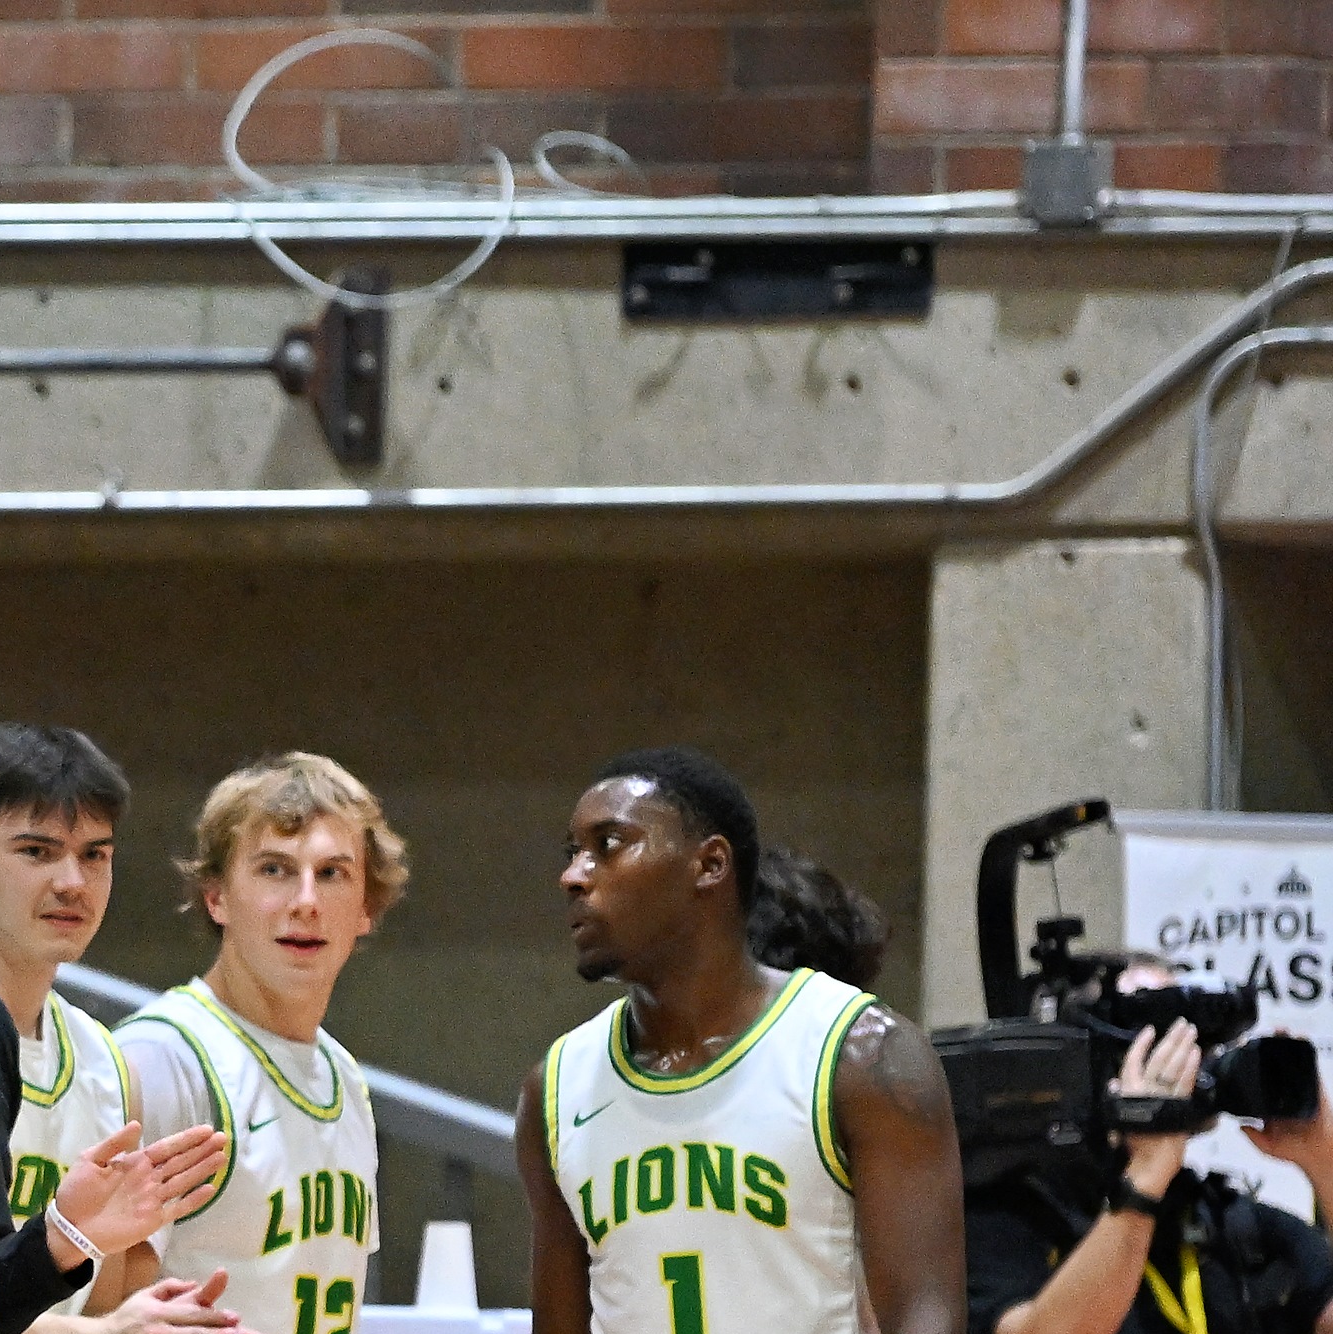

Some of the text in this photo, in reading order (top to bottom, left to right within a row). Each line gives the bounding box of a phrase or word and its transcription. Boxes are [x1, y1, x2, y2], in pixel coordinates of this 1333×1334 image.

[1159, 906, 1326, 951] CAPITOL
[261, 1168, 374, 1256] LION
[578, 1138, 790, 1247] LIONS
